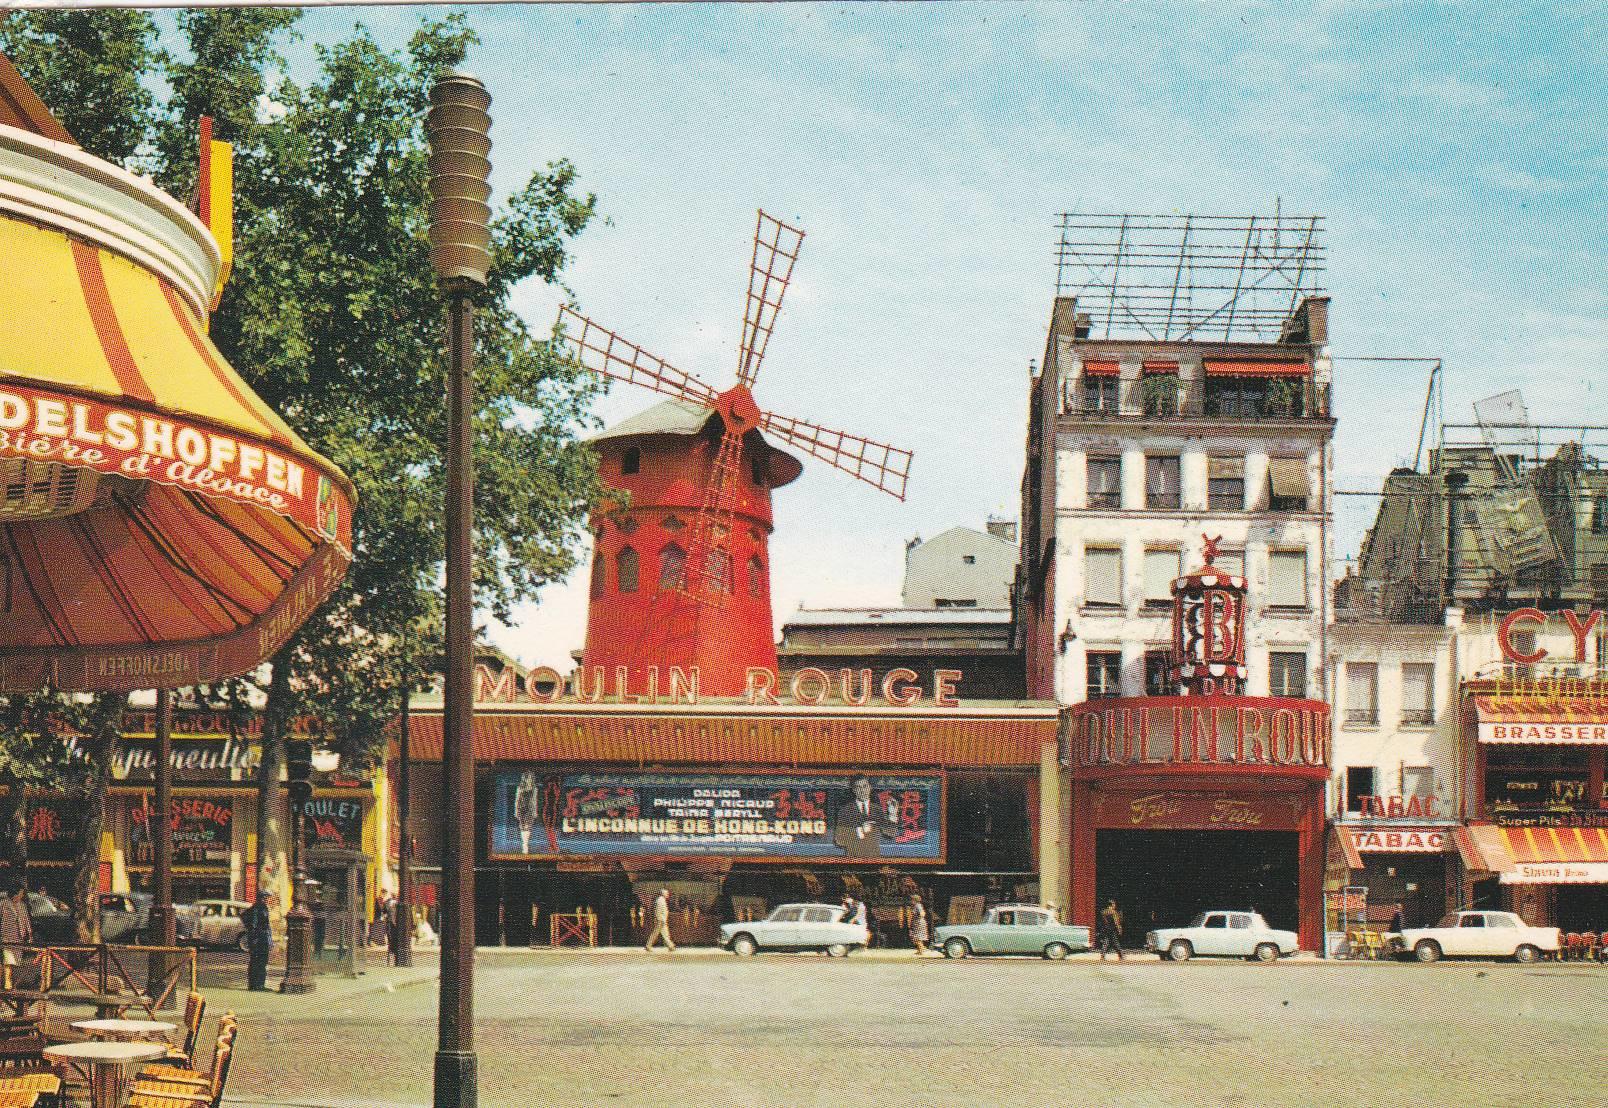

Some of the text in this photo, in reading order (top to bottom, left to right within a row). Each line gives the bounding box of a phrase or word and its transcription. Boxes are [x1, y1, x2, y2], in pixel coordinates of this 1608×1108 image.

[1497, 608, 1602, 664] CY
[474, 664, 962, 707] MOULIN ROUGE
[1203, 678, 1236, 696] DU
[1070, 706, 1330, 766] OULIN ROU
[1493, 726, 1607, 740] BRASSER
[693, 789, 741, 798] DALIDA
[292, 799, 361, 819] OULET
[653, 798, 775, 809] PHILIPPE NICAUD
[1357, 794, 1441, 818] TABAC
[562, 819, 827, 835] L'INCONNUE DE HONG-KONG
[1352, 833, 1443, 848] TABAC
